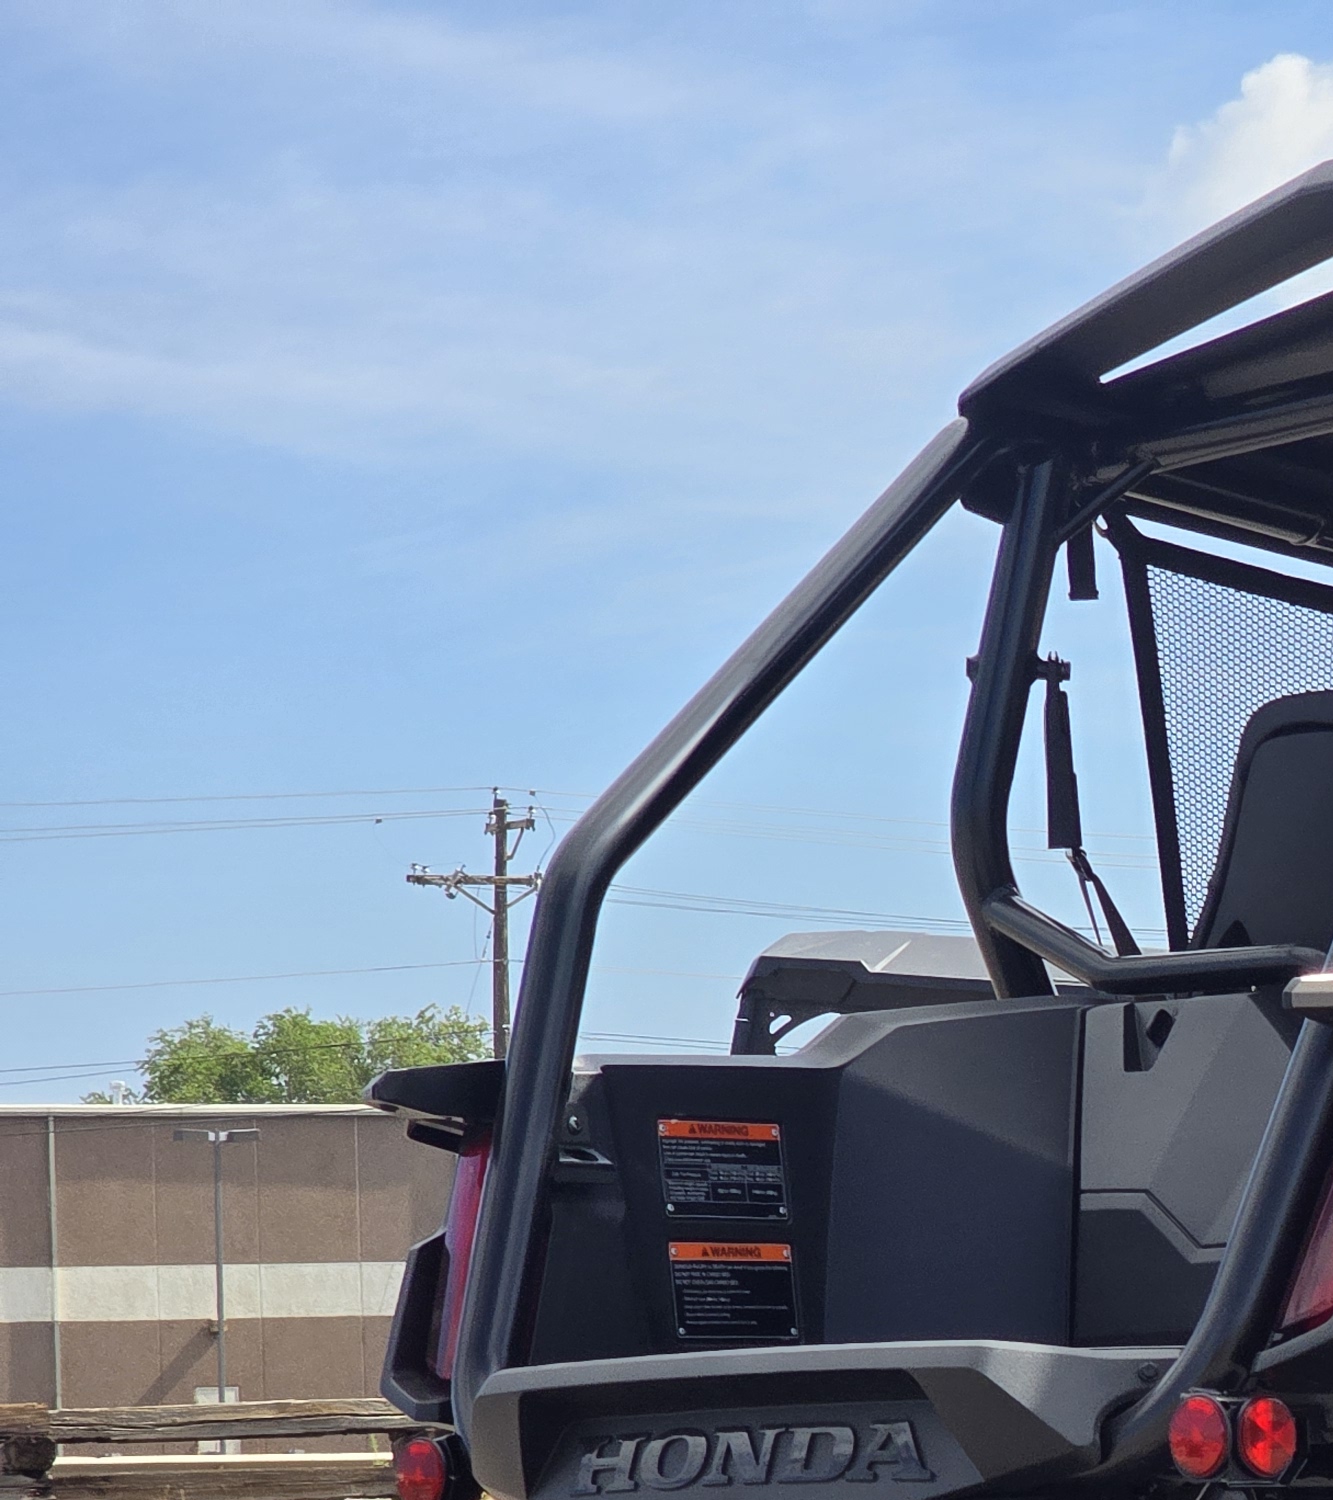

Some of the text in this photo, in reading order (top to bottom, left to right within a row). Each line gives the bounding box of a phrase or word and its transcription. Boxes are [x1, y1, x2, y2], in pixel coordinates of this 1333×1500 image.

[697, 1123, 750, 1137] WARNING
[709, 1246, 762, 1258] WARNING
[570, 1419, 938, 1498] HONDA
